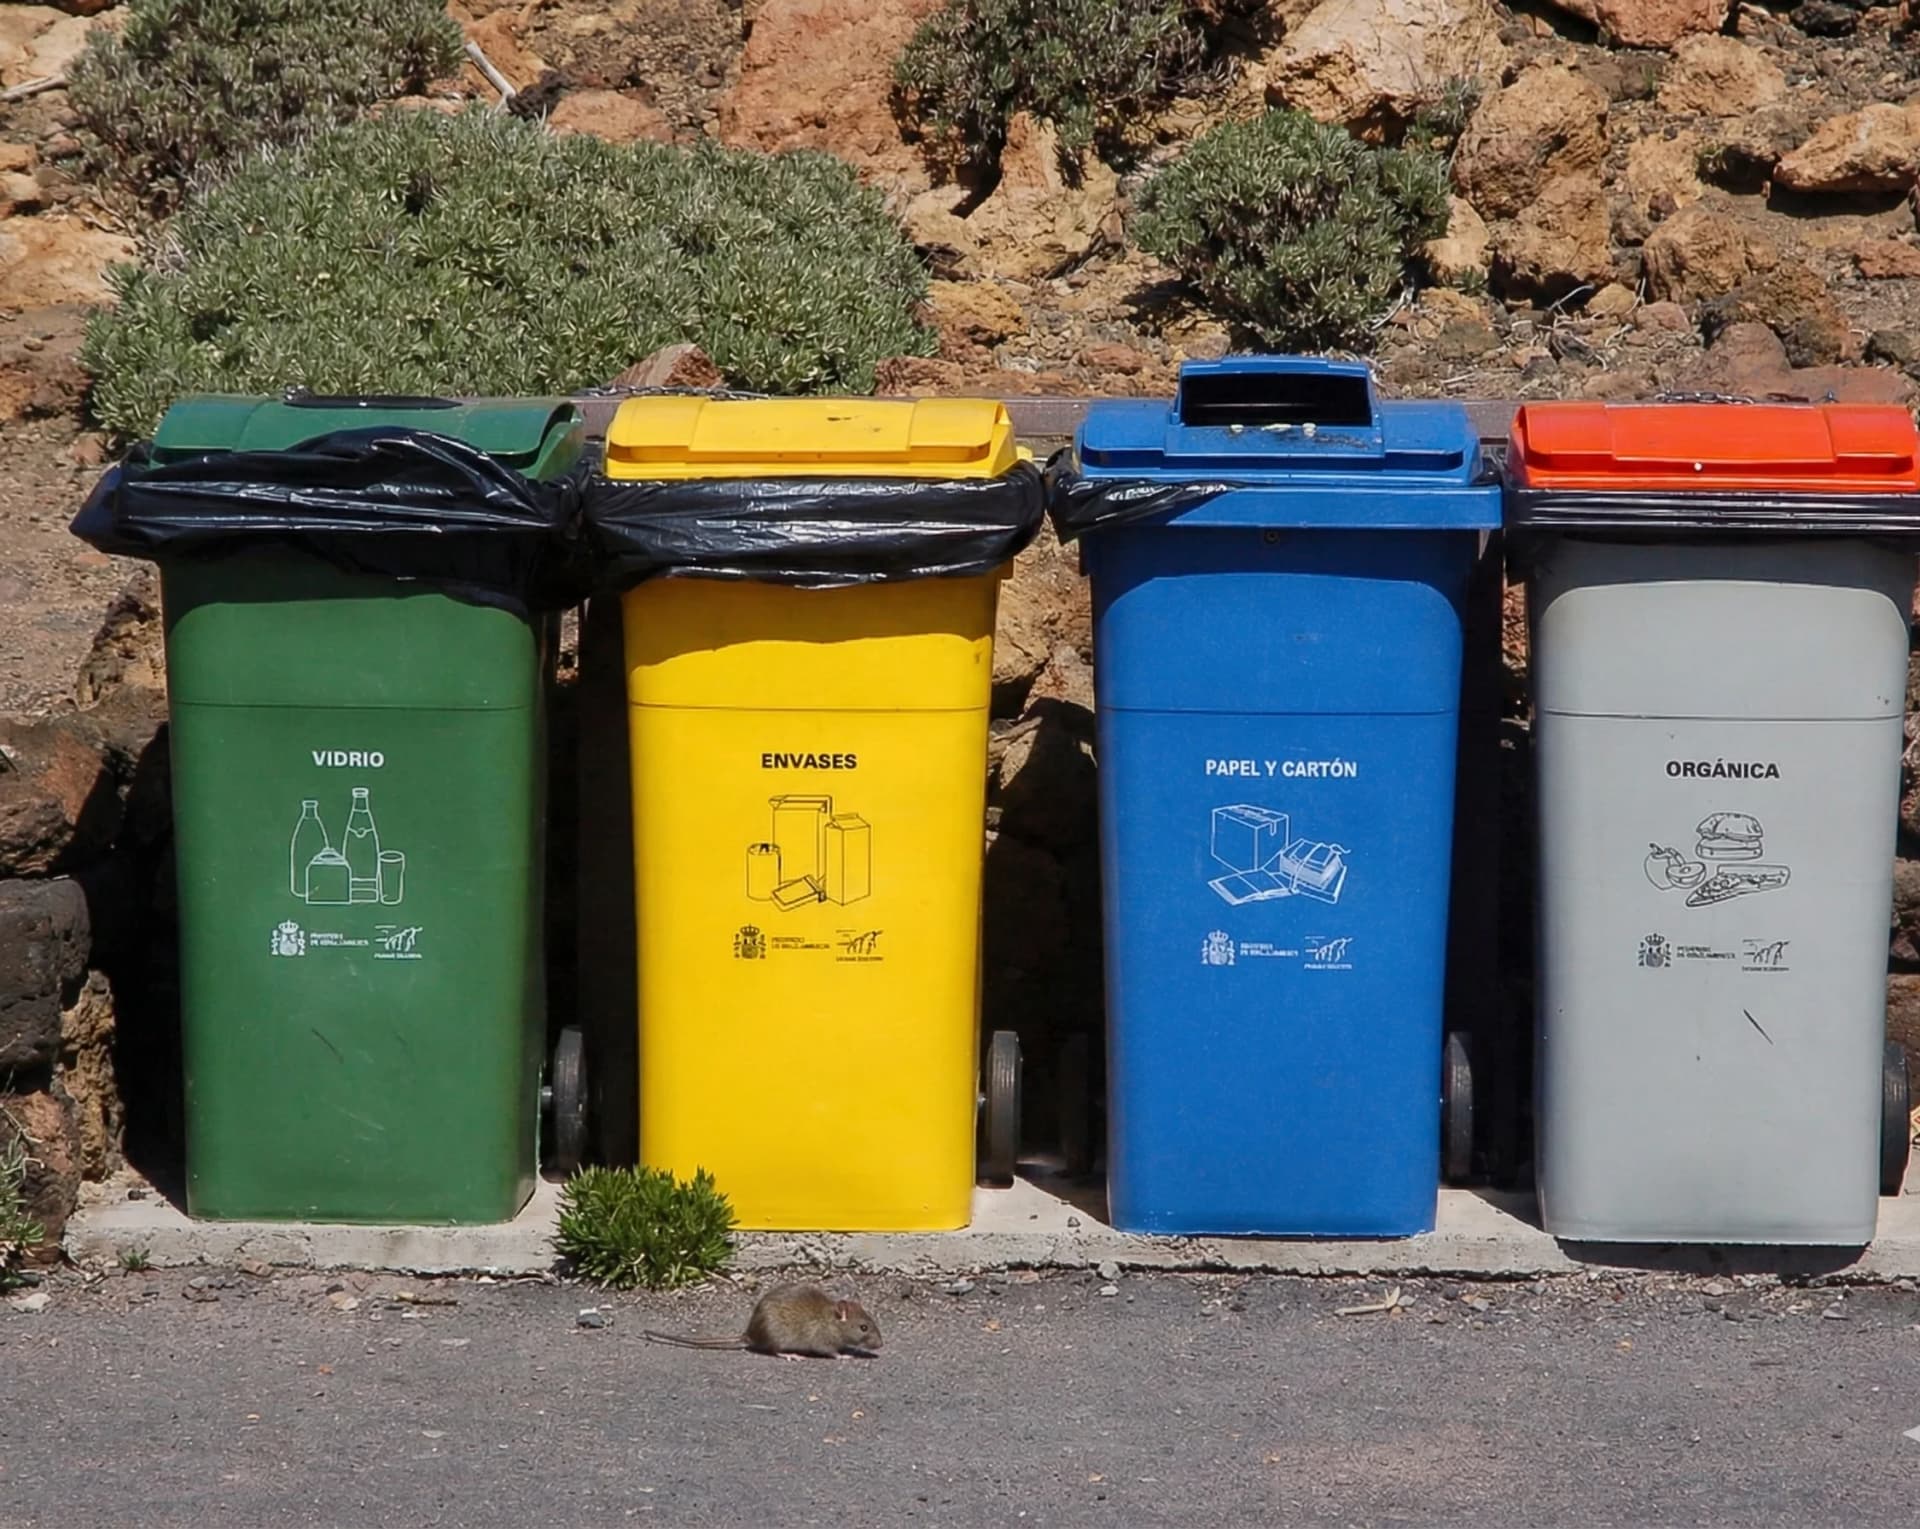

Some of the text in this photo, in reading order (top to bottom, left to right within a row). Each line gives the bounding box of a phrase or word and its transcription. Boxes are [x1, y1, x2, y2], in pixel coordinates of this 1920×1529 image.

[312, 750, 385, 768] VIDRIO
[761, 753, 858, 769] ENVASES
[1205, 757, 1357, 778] PAPEL Y CARTÓN
[1666, 757, 1780, 779] ORGÁNICA
